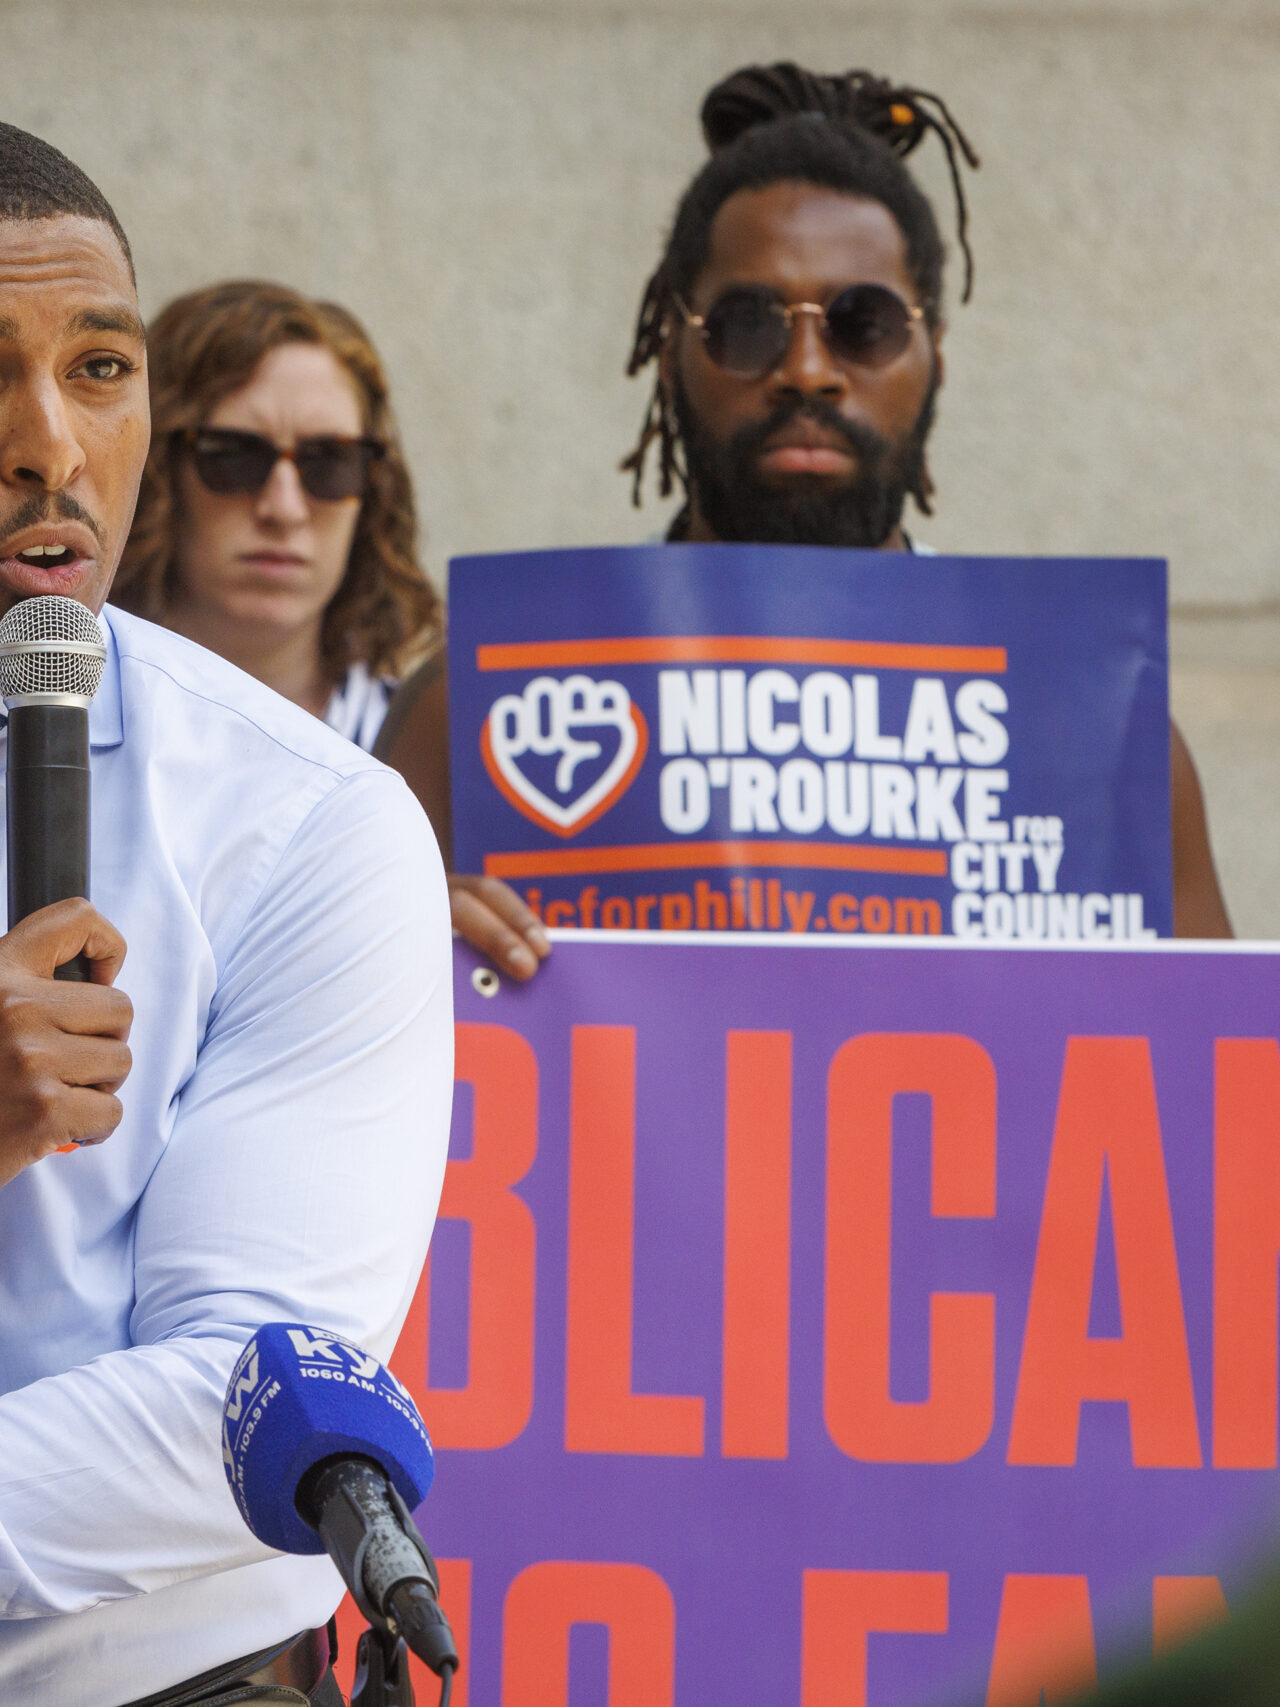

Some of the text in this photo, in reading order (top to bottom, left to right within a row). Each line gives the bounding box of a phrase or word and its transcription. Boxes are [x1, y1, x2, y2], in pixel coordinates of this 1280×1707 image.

[658, 668, 1010, 766] NICOLAS
[658, 757, 1064, 842] O'ROURKE FOR
[951, 841, 1065, 893] CITY
[525, 877, 942, 935] icforphilly.com
[951, 891, 1158, 939] COUNCIL
[240, 1407, 262, 1453] 103.9
[260, 1380, 282, 1408] FM
